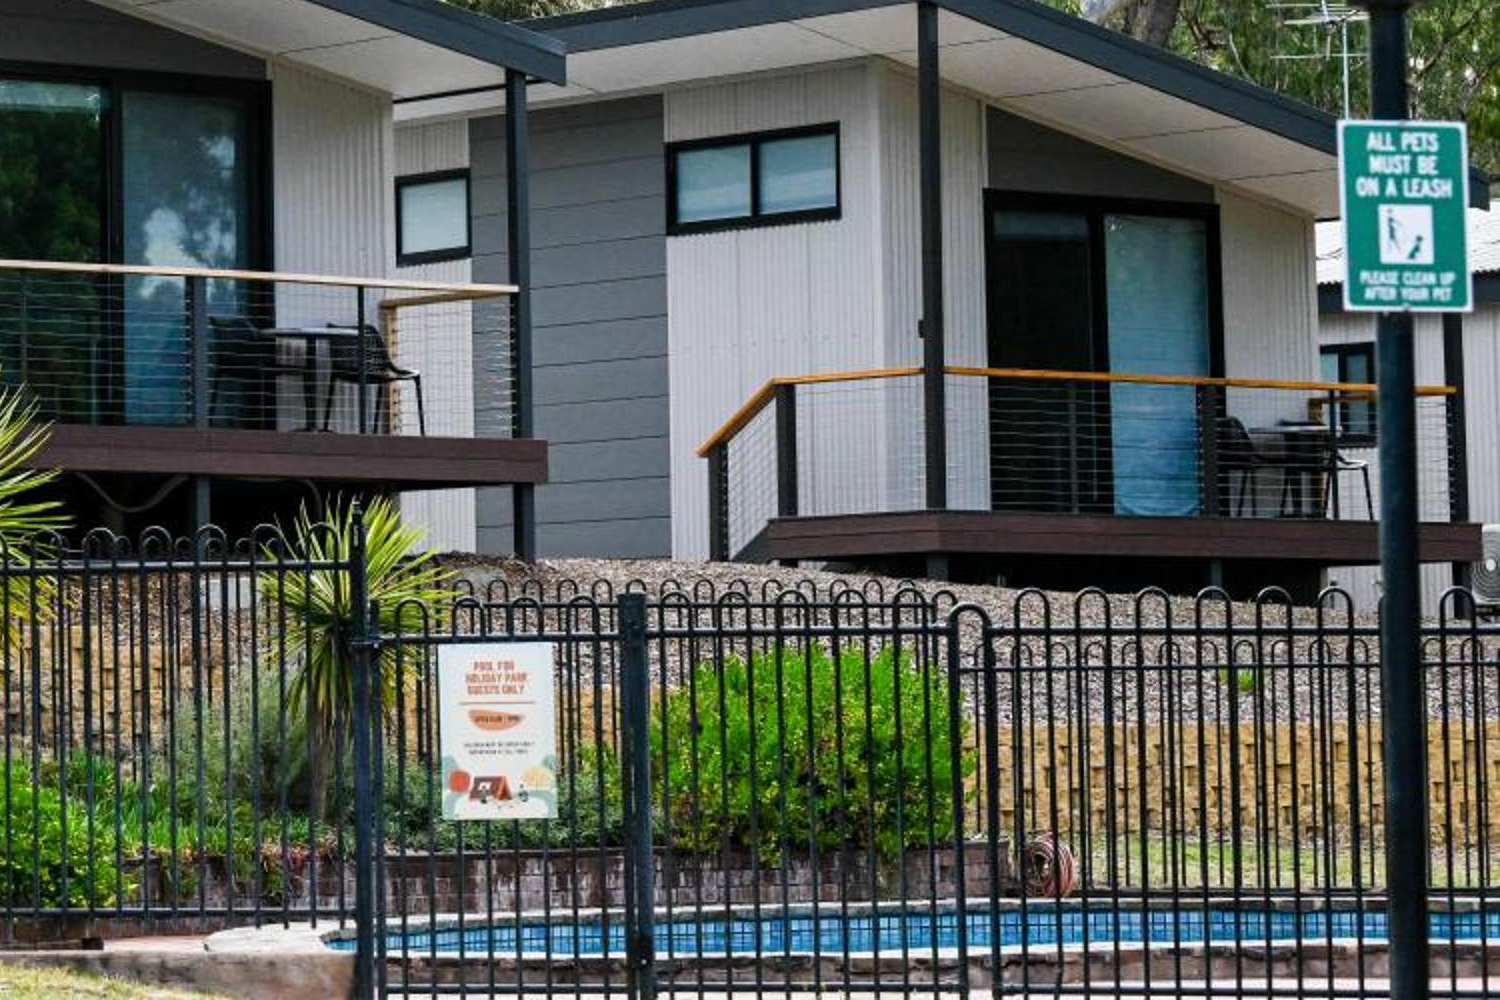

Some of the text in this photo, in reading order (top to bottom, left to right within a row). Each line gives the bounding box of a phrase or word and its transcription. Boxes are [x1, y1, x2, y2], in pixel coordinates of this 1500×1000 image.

[1366, 131, 1439, 152] ALL PETS
[1368, 154, 1439, 175] MUST BE
[1355, 176, 1453, 199] ON A LEASH
[1360, 271, 1456, 286] PLEASE CLEAN UP
[1364, 286, 1453, 302] AFTER YOUR PET
